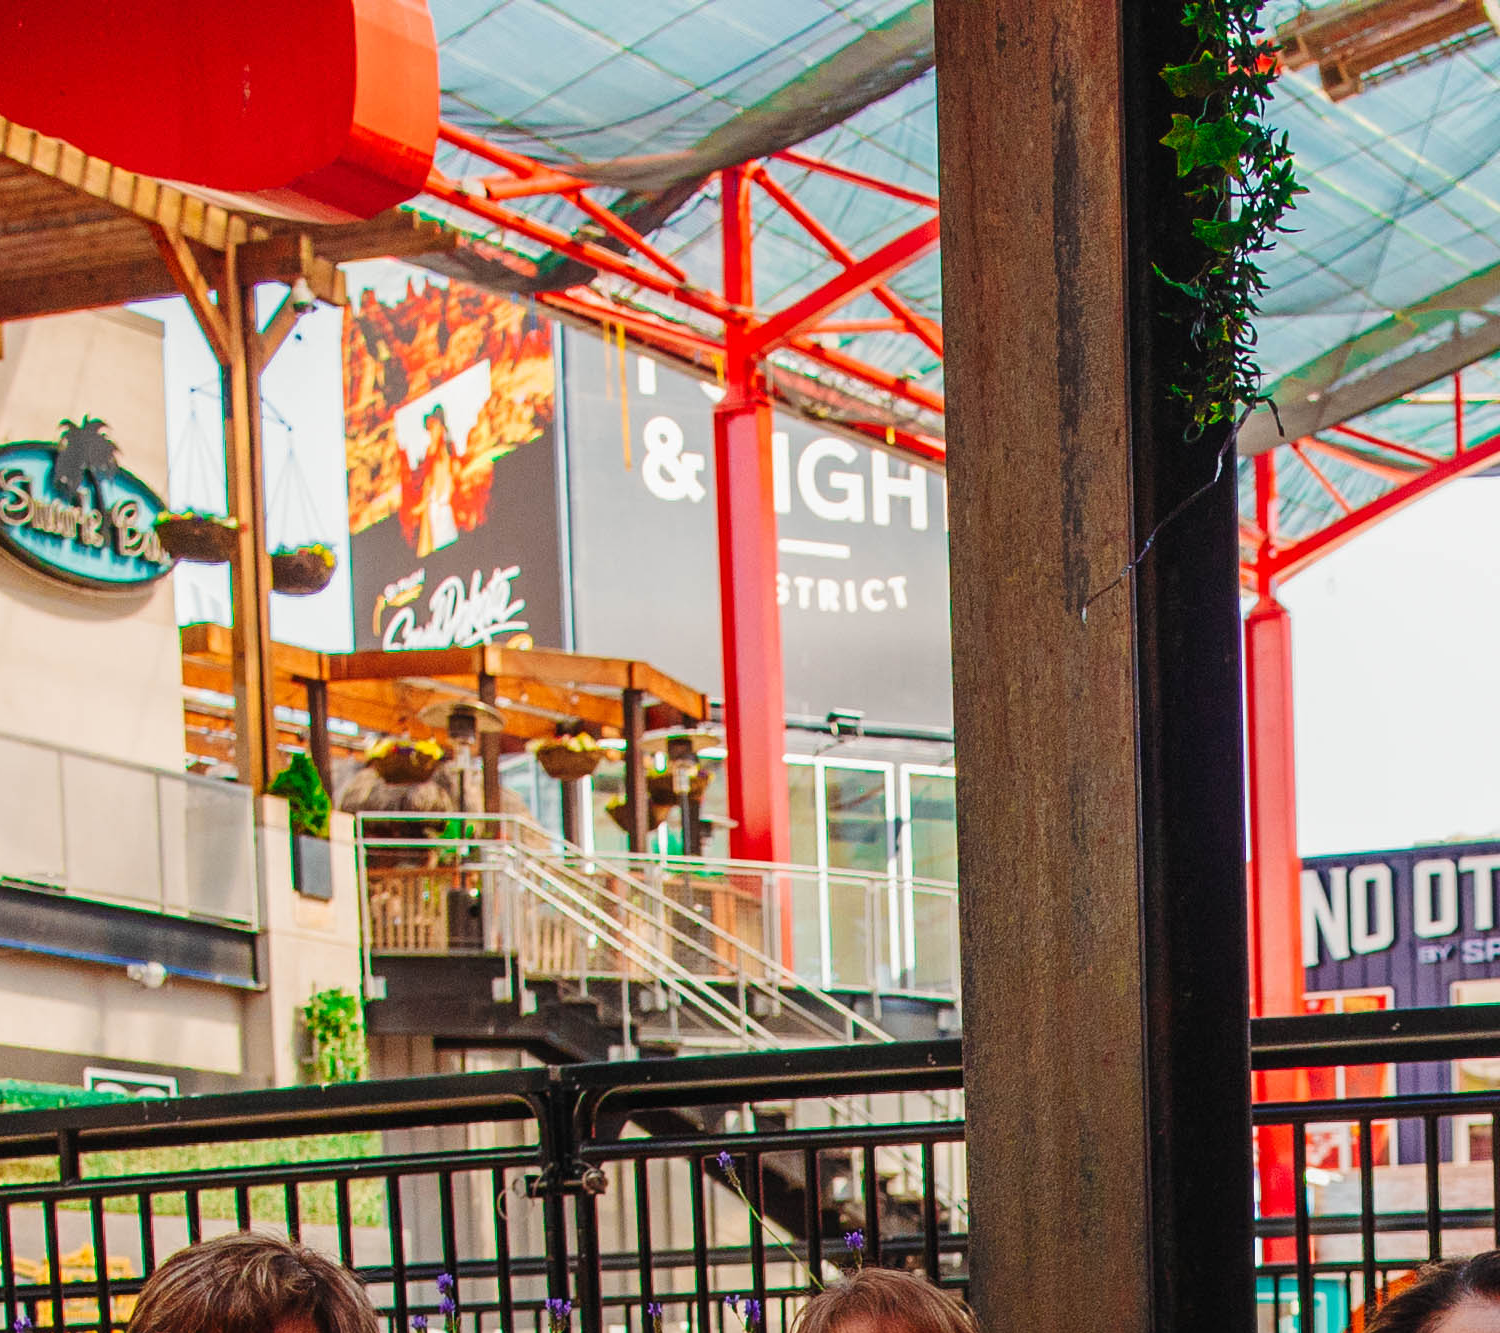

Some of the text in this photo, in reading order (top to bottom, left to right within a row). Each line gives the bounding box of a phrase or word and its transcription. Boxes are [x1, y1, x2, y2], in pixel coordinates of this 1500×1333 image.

[642, 416, 948, 531] & IGH
[776, 572, 908, 613] STRICT
[1300, 862, 1396, 967] NO
[1418, 943, 1455, 965] BY
